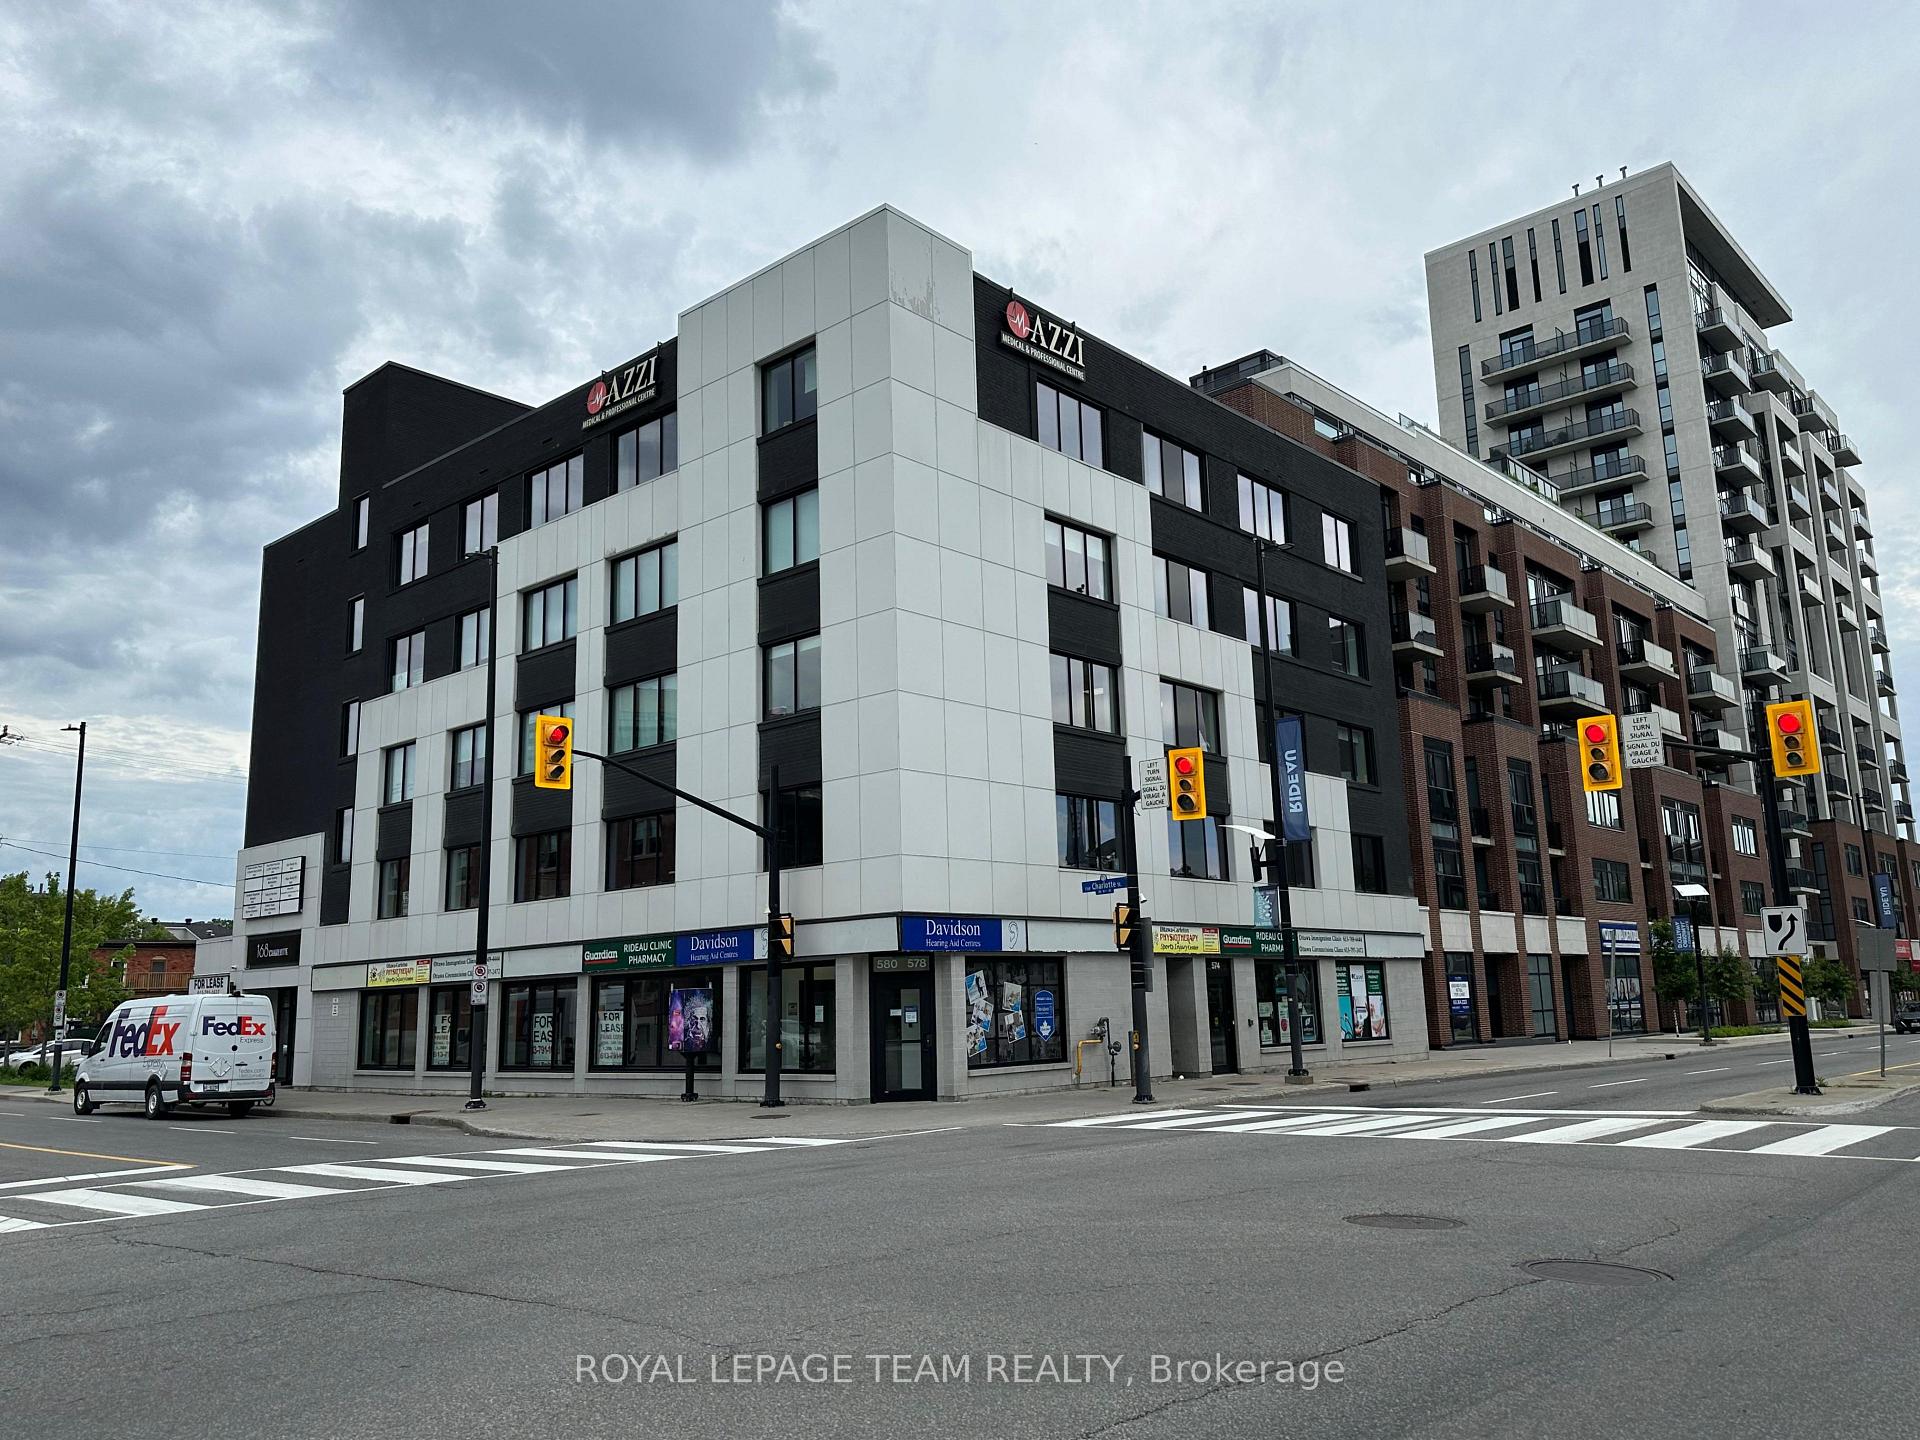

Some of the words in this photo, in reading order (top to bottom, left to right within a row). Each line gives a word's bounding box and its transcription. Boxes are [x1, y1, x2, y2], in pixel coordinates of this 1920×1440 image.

[1026, 314, 1085, 367] AZZI
[1002, 333, 1026, 352] MEDICAL
[1025, 345, 1030, 354] &
[1030, 347, 1066, 372] PROFESSIONAL
[1066, 365, 1085, 381] CENTRE
[605, 355, 658, 406] AZZI
[582, 415, 601, 429] MEDICAL
[606, 396, 637, 417] PROFESSIONAL
[637, 387, 656, 403] CENTRE
[1632, 716, 1647, 724] LEFT
[1630, 731, 1654, 739] SIGNAL
[1632, 756, 1658, 764] GAUCHE
[1092, 882, 1116, 890] Charlotte
[925, 919, 981, 936] Davidson
[690, 933, 738, 951] Davidson
[1160, 933, 1199, 942] PHYSIOTHERAPY
[1223, 934, 1252, 945] Guardian
[1256, 932, 1277, 941] RIDEAU
[623, 942, 648, 953] RIDEAU
[649, 940, 672, 951] CLINIC
[926, 939, 949, 948] Hearing
[950, 939, 960, 947] Aid
[960, 939, 981, 947] Centres
[257, 944, 269, 958] 168
[584, 950, 618, 960] Guardian
[690, 953, 709, 962] Hearing
[710, 951, 719, 960] Aid
[720, 950, 738, 959] Centres
[628, 953, 667, 964] PHARMACY
[877, 960, 898, 969] 580
[907, 959, 927, 968] 578
[1211, 961, 1220, 970] 574
[194, 979, 205, 989] FOR
[206, 978, 224, 989] LEASE
[603, 1012, 620, 1021] FOR
[108, 1005, 181, 1058] FedEx
[202, 1016, 266, 1036] FedEx
[240, 1036, 264, 1044] Express
